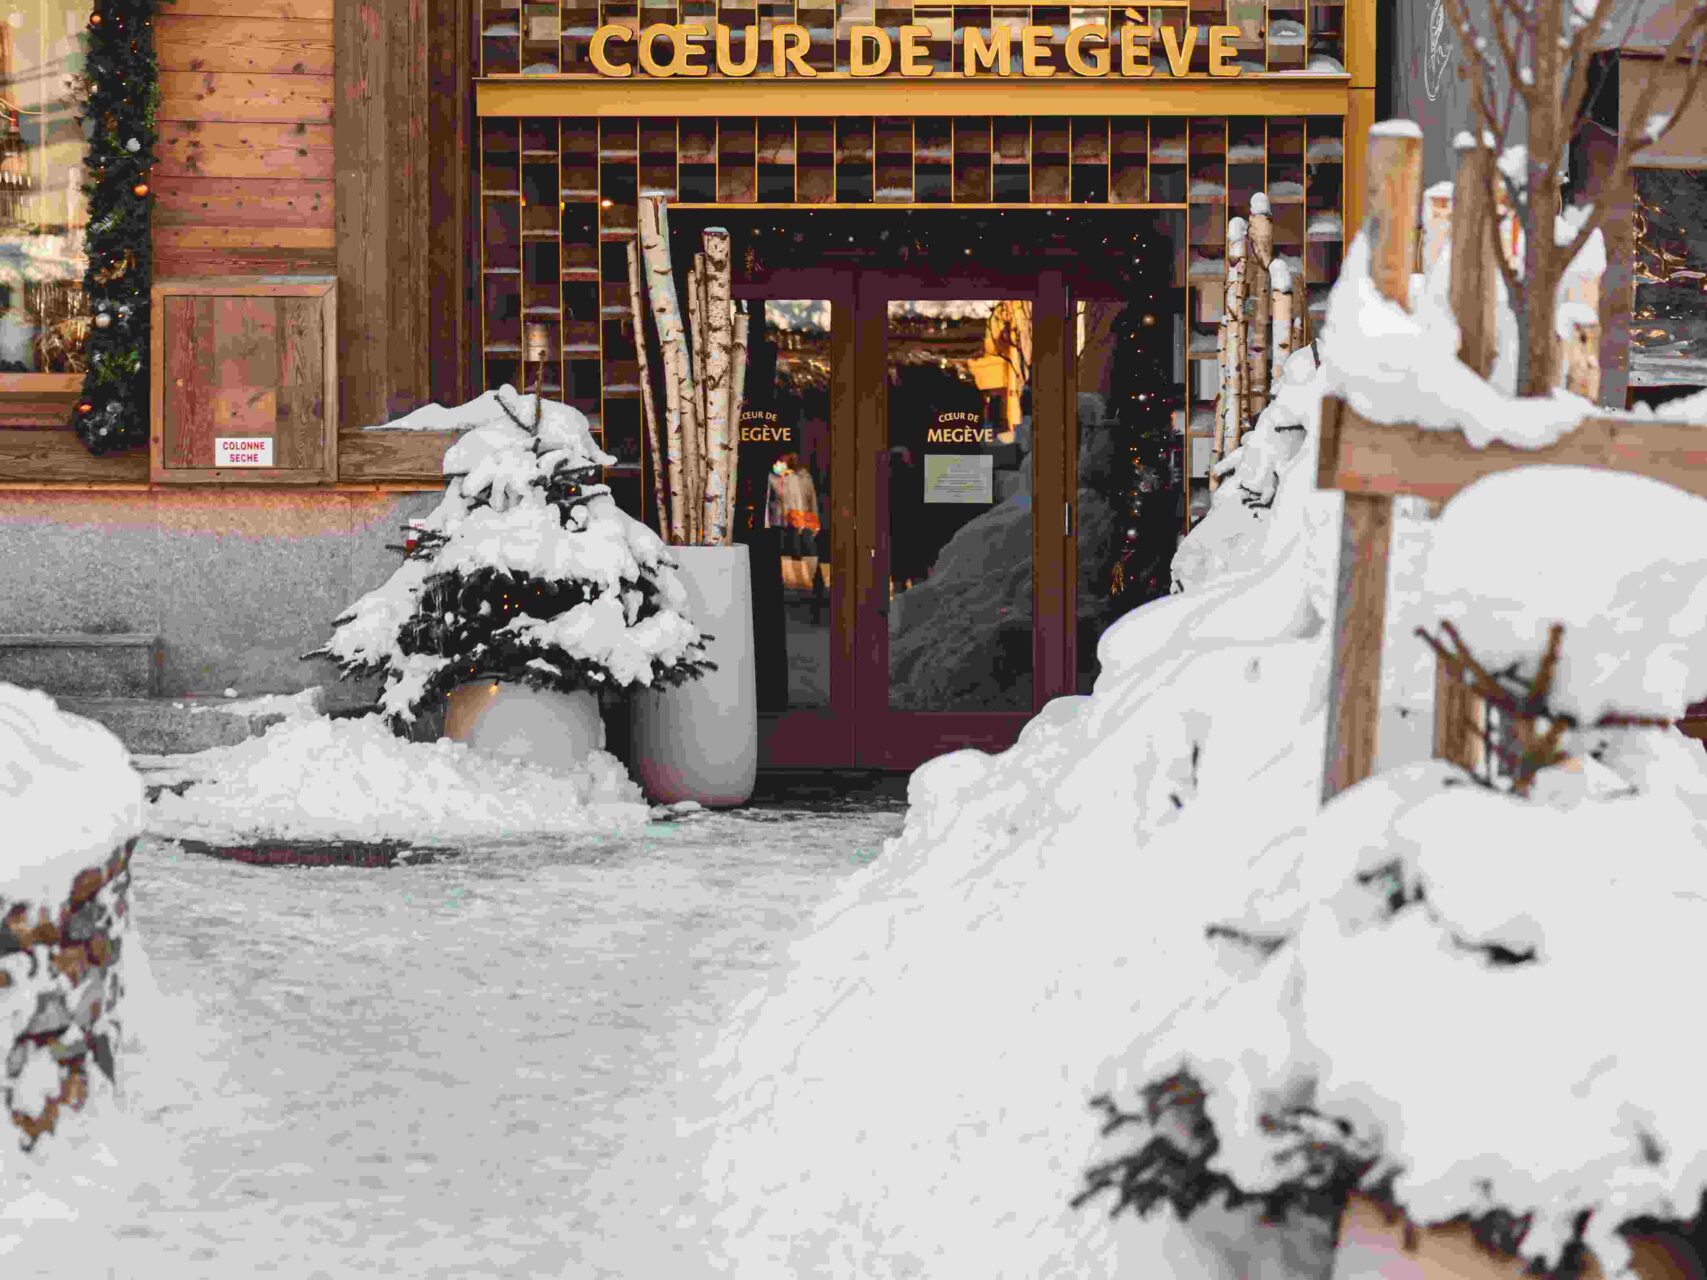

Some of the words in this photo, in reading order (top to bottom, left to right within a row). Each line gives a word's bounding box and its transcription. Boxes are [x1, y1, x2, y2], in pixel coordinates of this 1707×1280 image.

[589, 23, 816, 78] CŒUR
[849, 25, 934, 77] DE
[962, 6, 1244, 78] MEGÈVE
[740, 411, 764, 421] ŒUR
[765, 411, 778, 422] DE
[938, 412, 966, 423] CŒUR
[967, 413, 980, 423] DE
[739, 424, 792, 442] EGÈVE
[927, 424, 994, 443] MEGÈVE
[222, 441, 266, 451] COLONNE
[229, 453, 259, 463] SECHE
